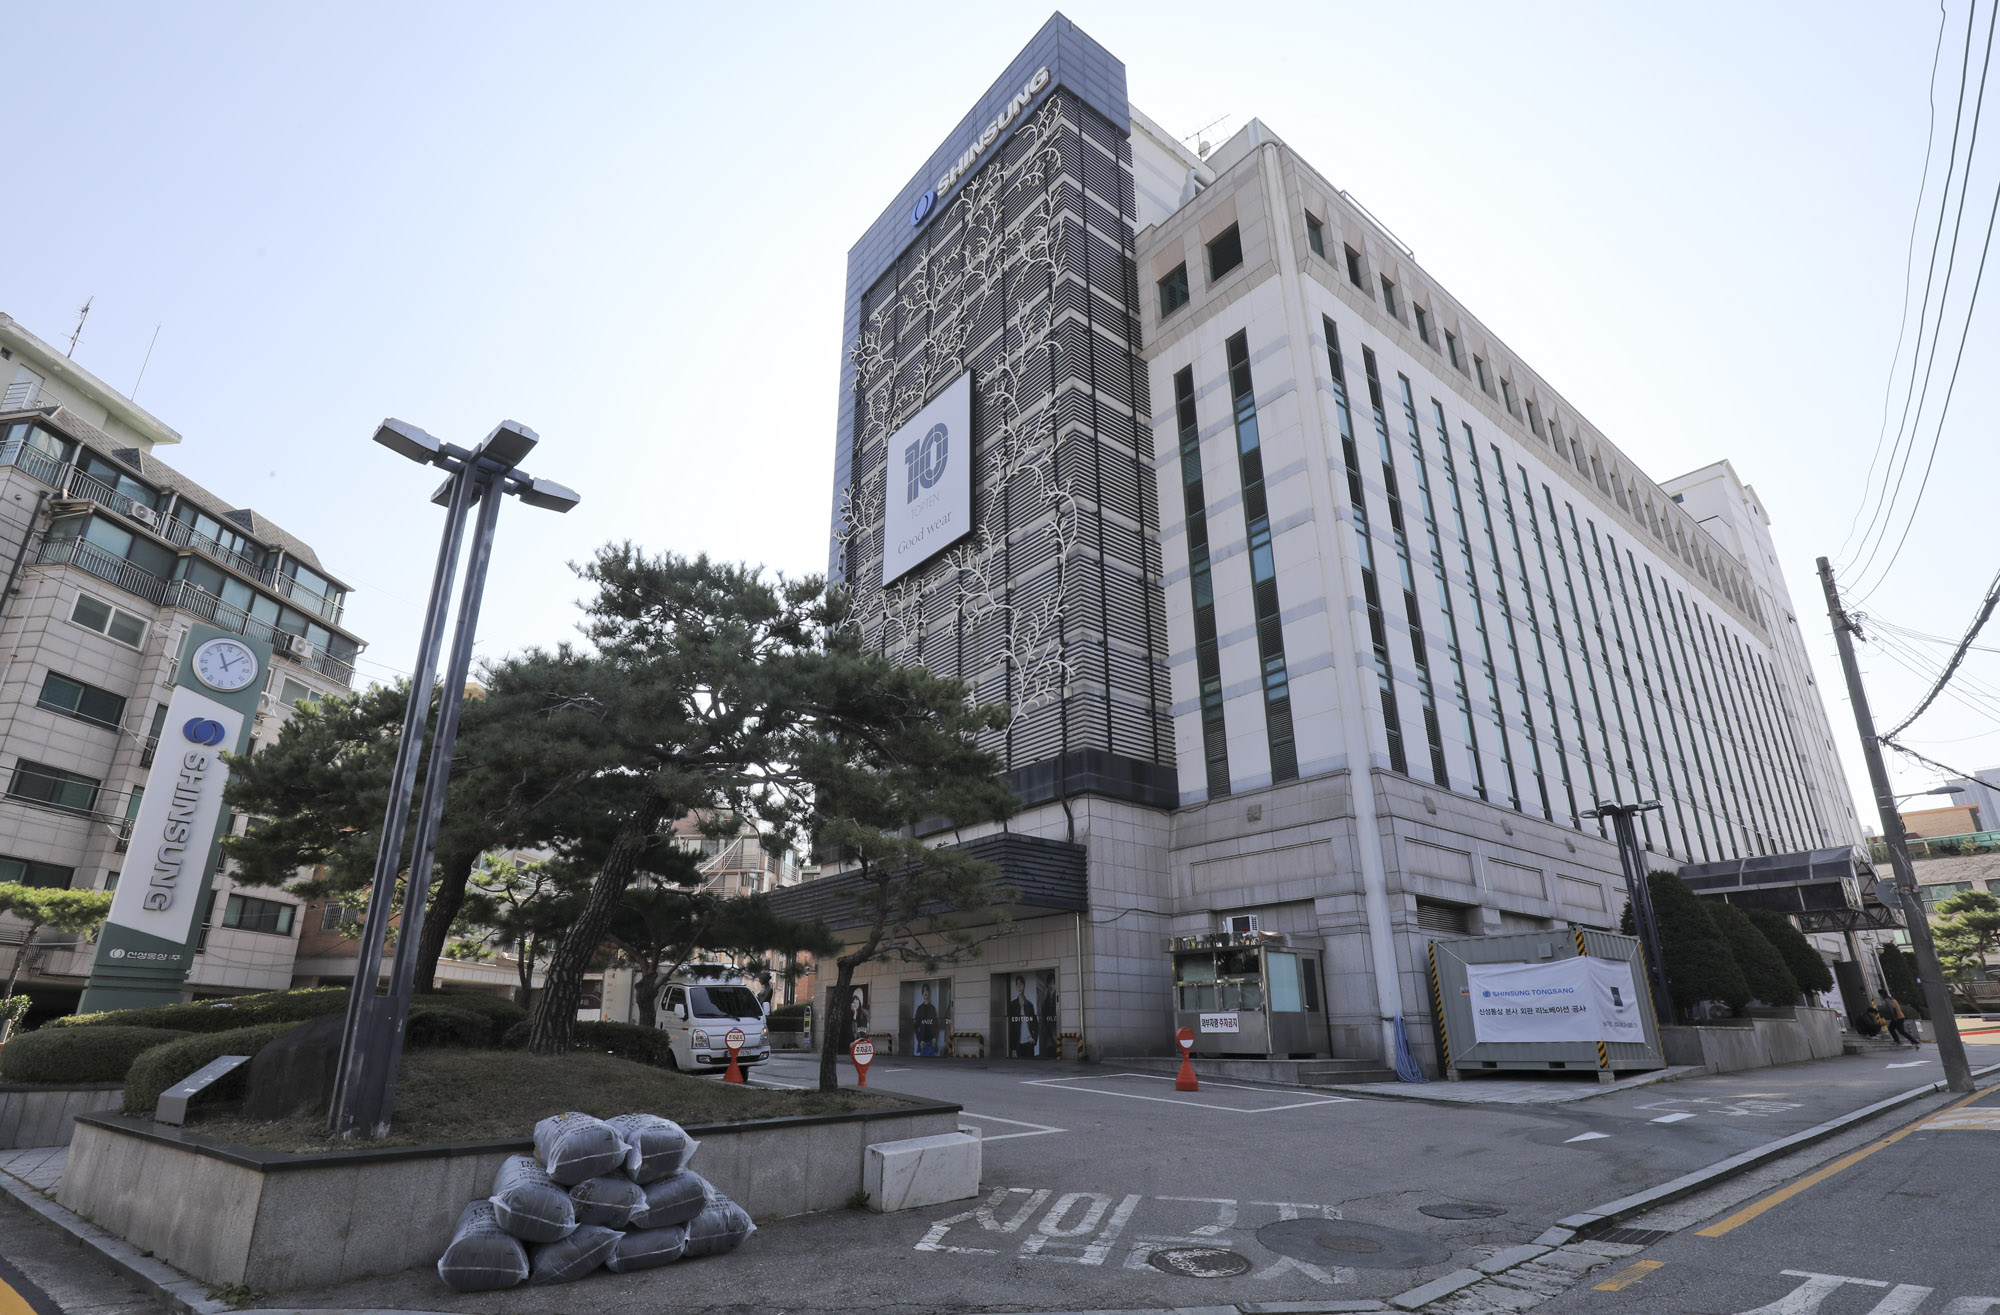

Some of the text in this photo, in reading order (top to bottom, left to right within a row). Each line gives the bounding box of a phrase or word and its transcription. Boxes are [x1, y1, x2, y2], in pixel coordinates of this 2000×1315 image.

[937, 66, 1051, 198] SHINSUNG
[905, 422, 949, 505] 10
[898, 511, 952, 555] Good wear
[143, 750, 209, 912] SHINSUNG
[127, 951, 168, 961] 신성통상
[1492, 987, 1575, 998] SHINSUNG TONGSANG
[1219, 1017, 1238, 1028] 주차금지
[1479, 1005, 1587, 1016] 신성통상 본사 외관 리노베이션 공사
